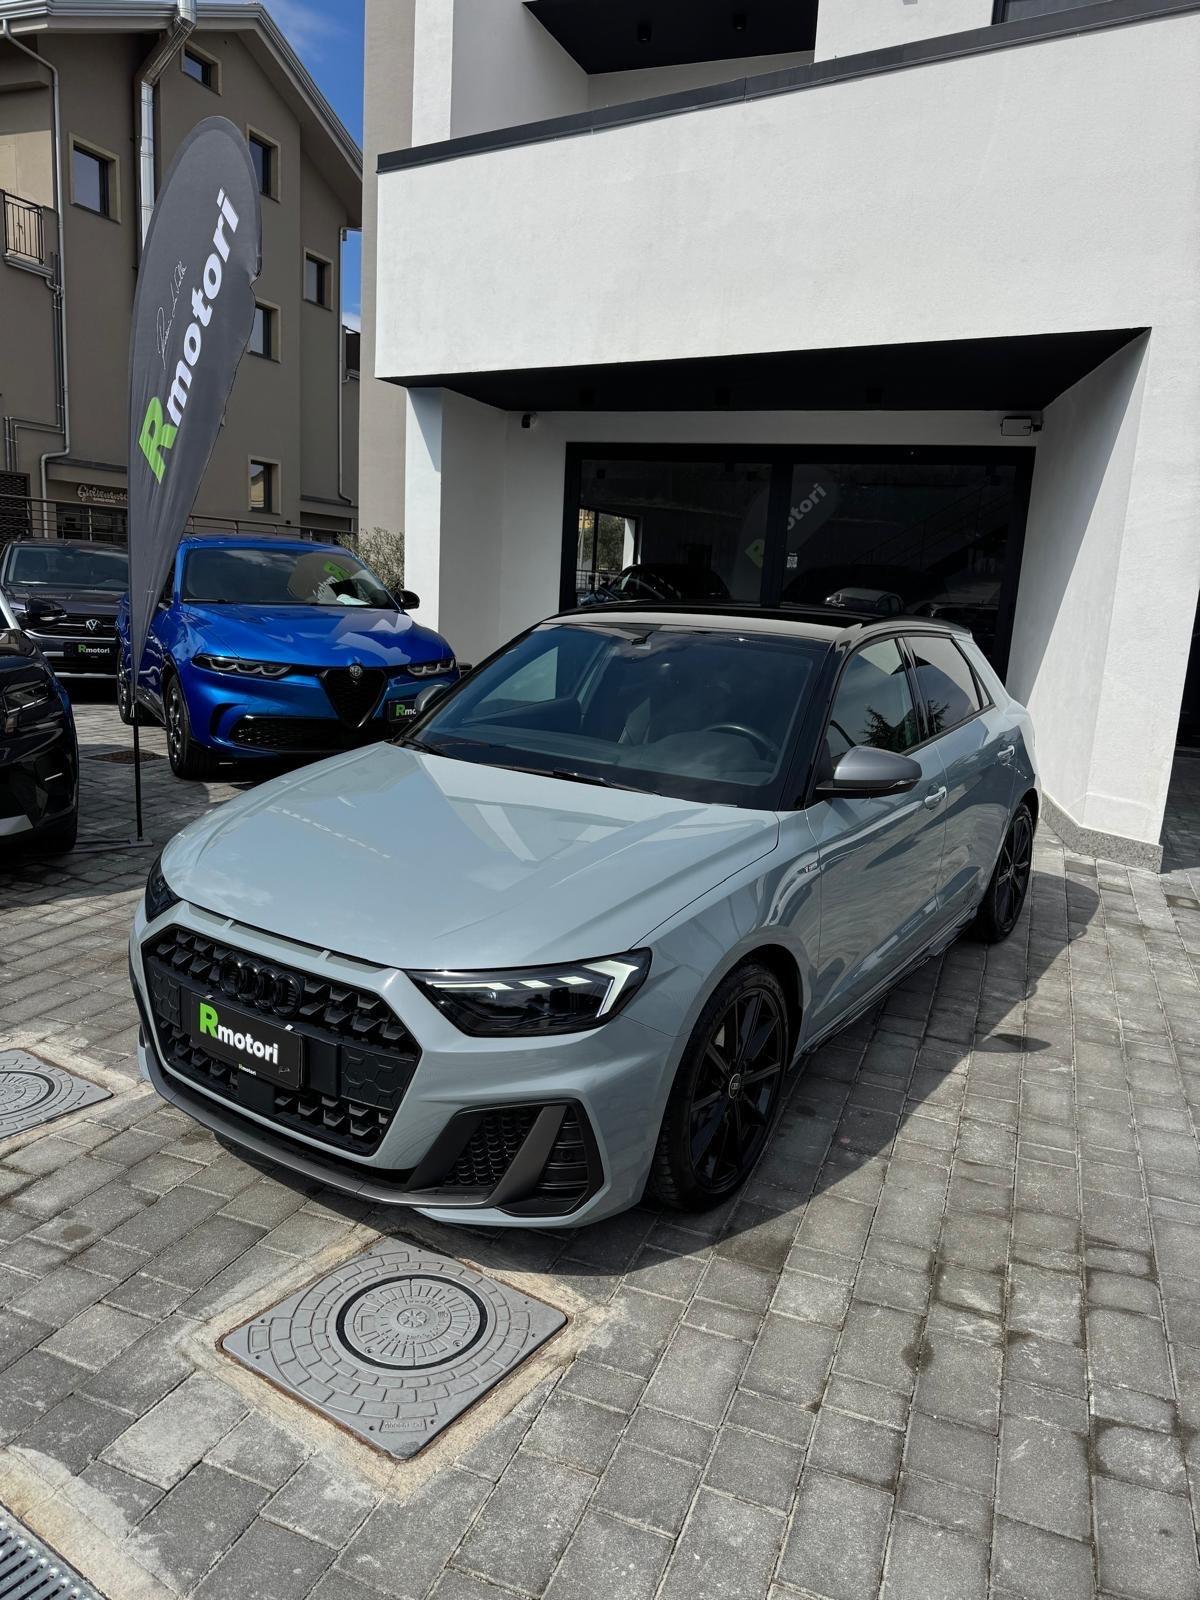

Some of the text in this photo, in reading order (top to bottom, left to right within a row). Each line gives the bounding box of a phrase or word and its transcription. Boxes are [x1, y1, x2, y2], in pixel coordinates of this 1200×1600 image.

[139, 188, 239, 484] Rmotori
[78, 644, 110, 654] Rmotori
[199, 1002, 278, 1064] Rmotori
